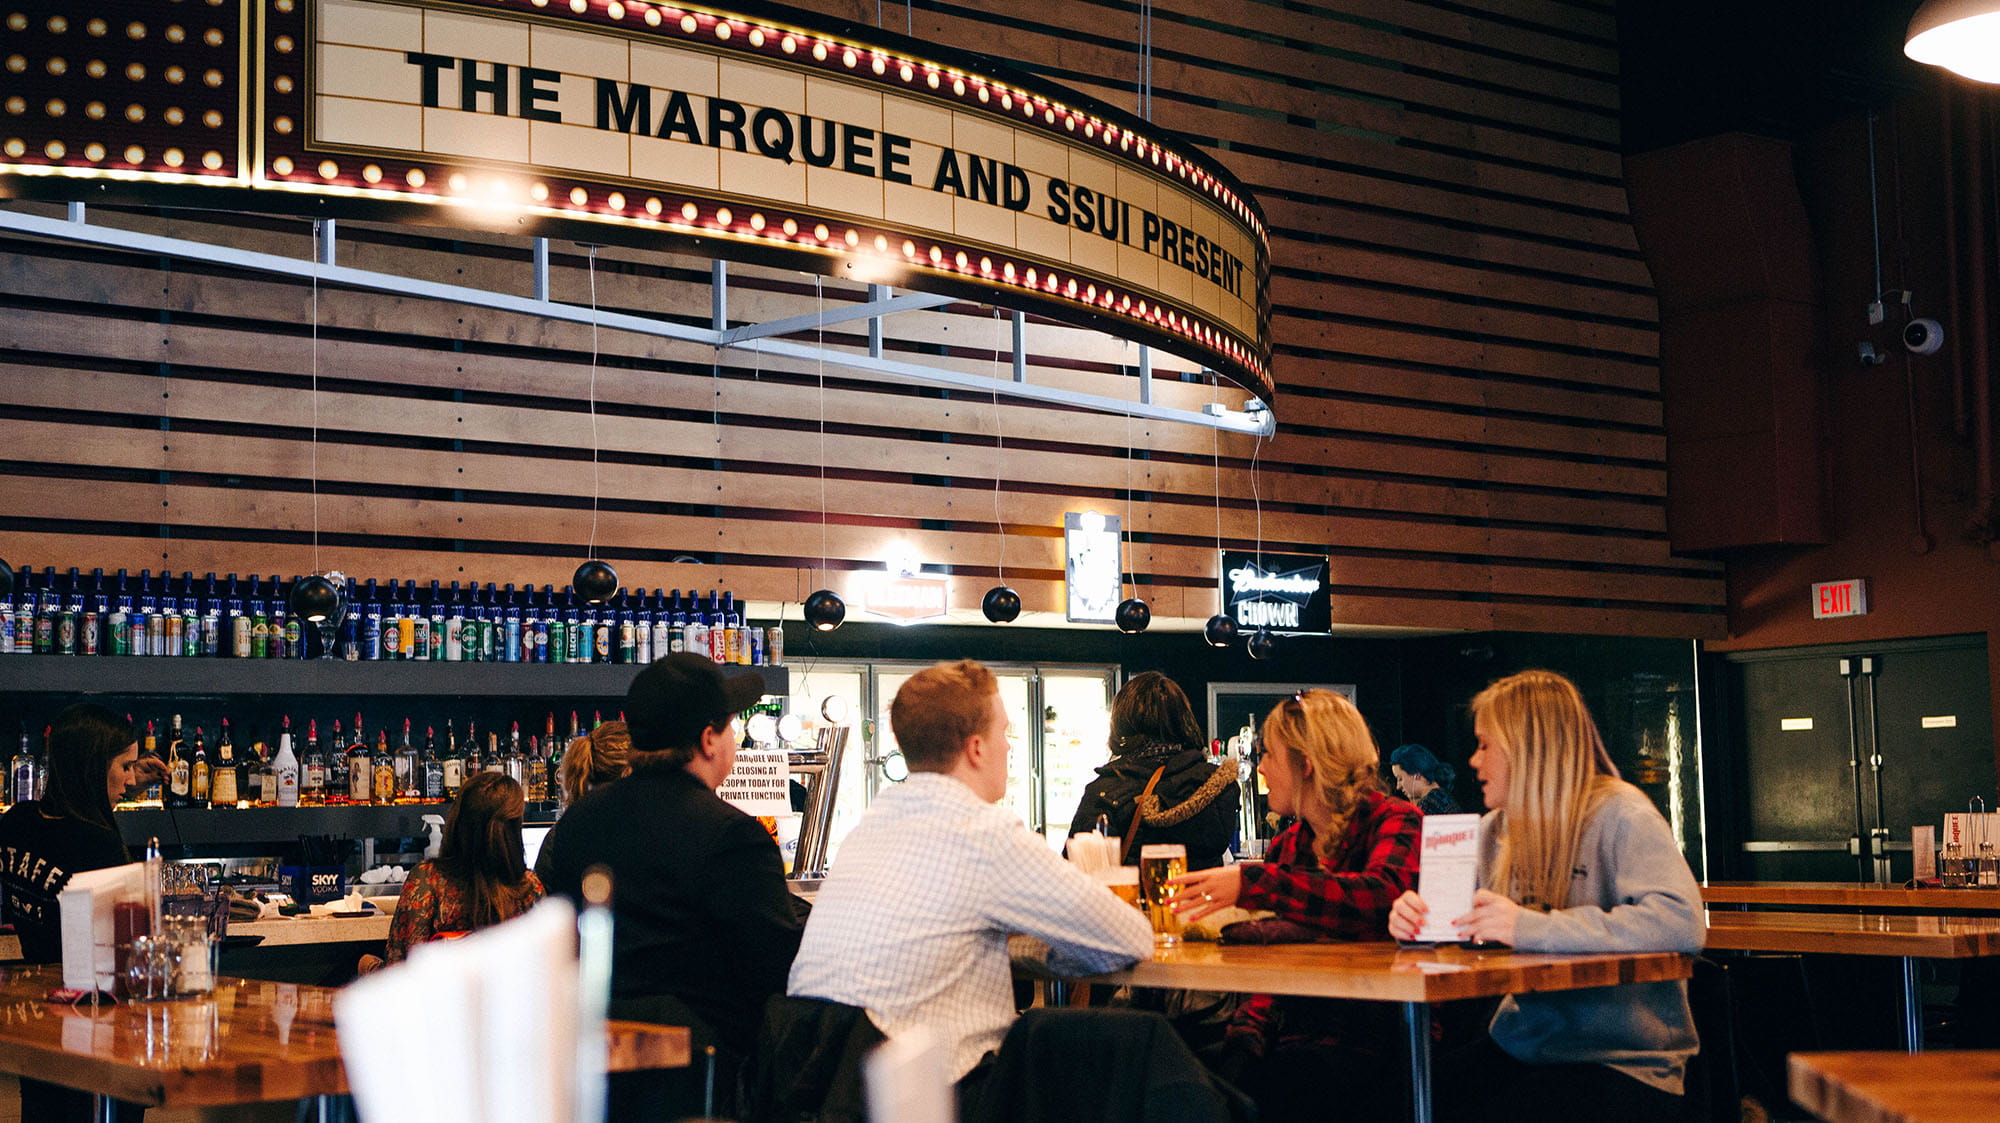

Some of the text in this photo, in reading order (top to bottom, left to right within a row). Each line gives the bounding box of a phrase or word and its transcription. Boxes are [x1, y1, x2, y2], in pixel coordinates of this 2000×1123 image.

[405, 51, 1244, 299] THE MARQUEE AND SSUI PRESENT
[1819, 583, 1853, 615] EXIT
[767, 754, 784, 763] WILL
[737, 766, 767, 775] CLOSING
[768, 766, 777, 775] AT
[748, 779, 771, 788] TODAY
[772, 779, 786, 788] FOR
[720, 791, 786, 801] PRIVATE FUNCTION
[311, 874, 339, 886] SKYY
[311, 886, 339, 894] VODKA
